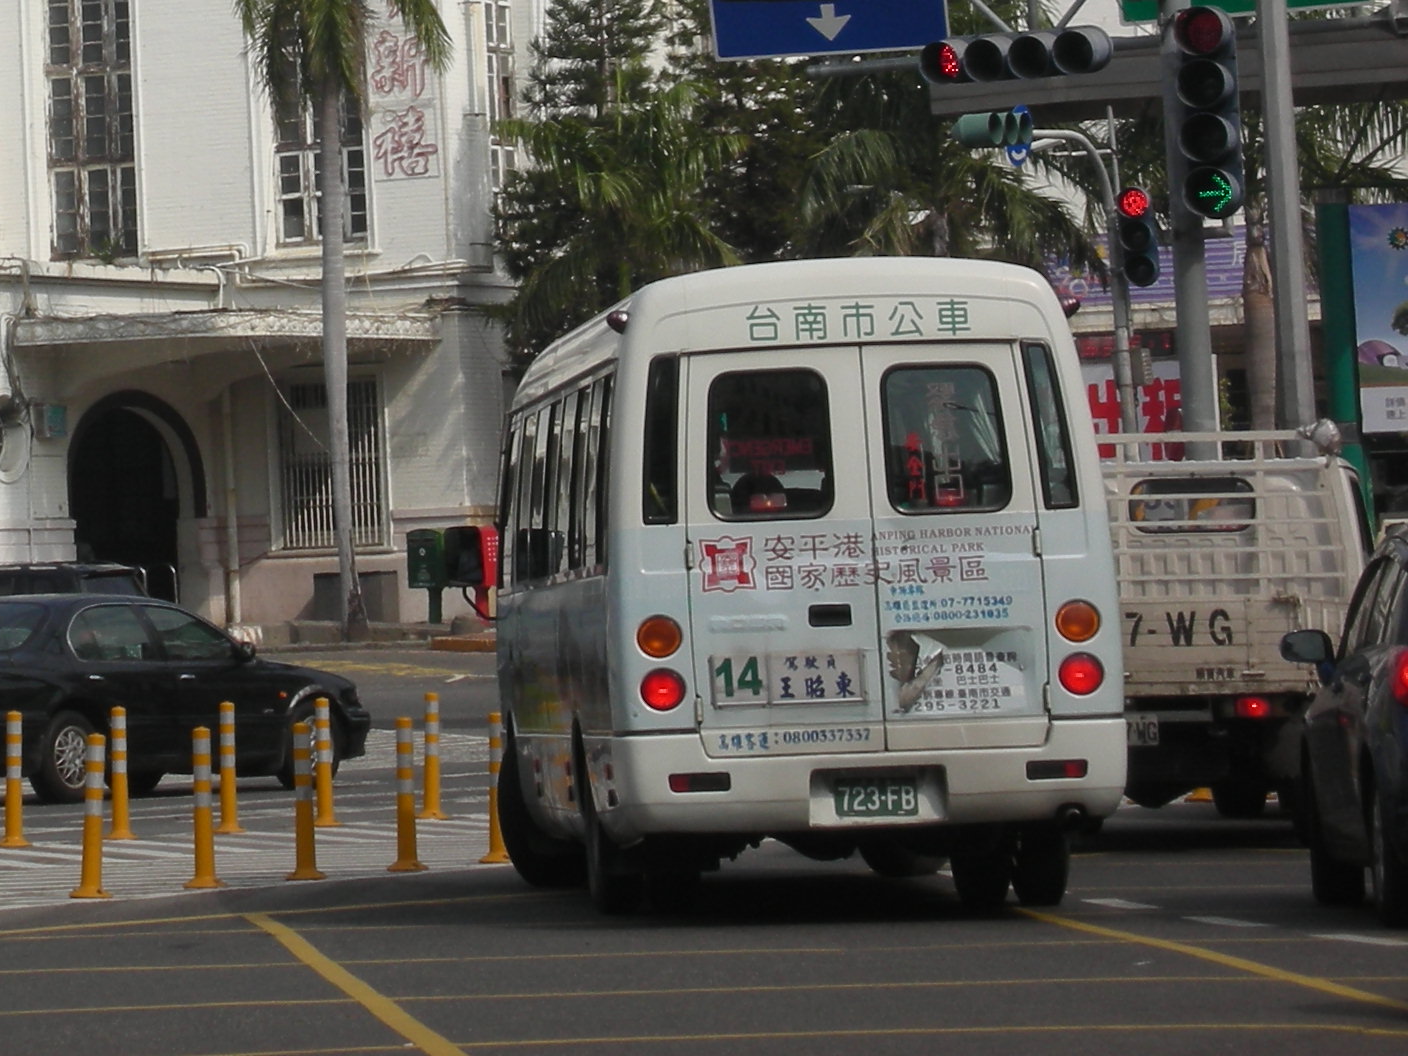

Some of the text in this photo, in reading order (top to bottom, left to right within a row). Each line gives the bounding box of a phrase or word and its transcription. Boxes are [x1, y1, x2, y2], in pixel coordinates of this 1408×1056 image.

[746, 299, 971, 341] 台南市公車
[764, 532, 865, 562] 安平港
[872, 530, 916, 542] ANPING
[920, 527, 971, 539] HARBOR
[873, 542, 984, 556] HISTORICAL PARK
[764, 555, 989, 591] 國家歷史風景區
[940, 595, 1013, 608] 07-7715349
[784, 655, 837, 671] 駕駛員
[715, 656, 763, 697] 14
[780, 672, 856, 699] 王昭東
[783, 728, 871, 744] 0800337337
[838, 786, 916, 812] 723-FB
